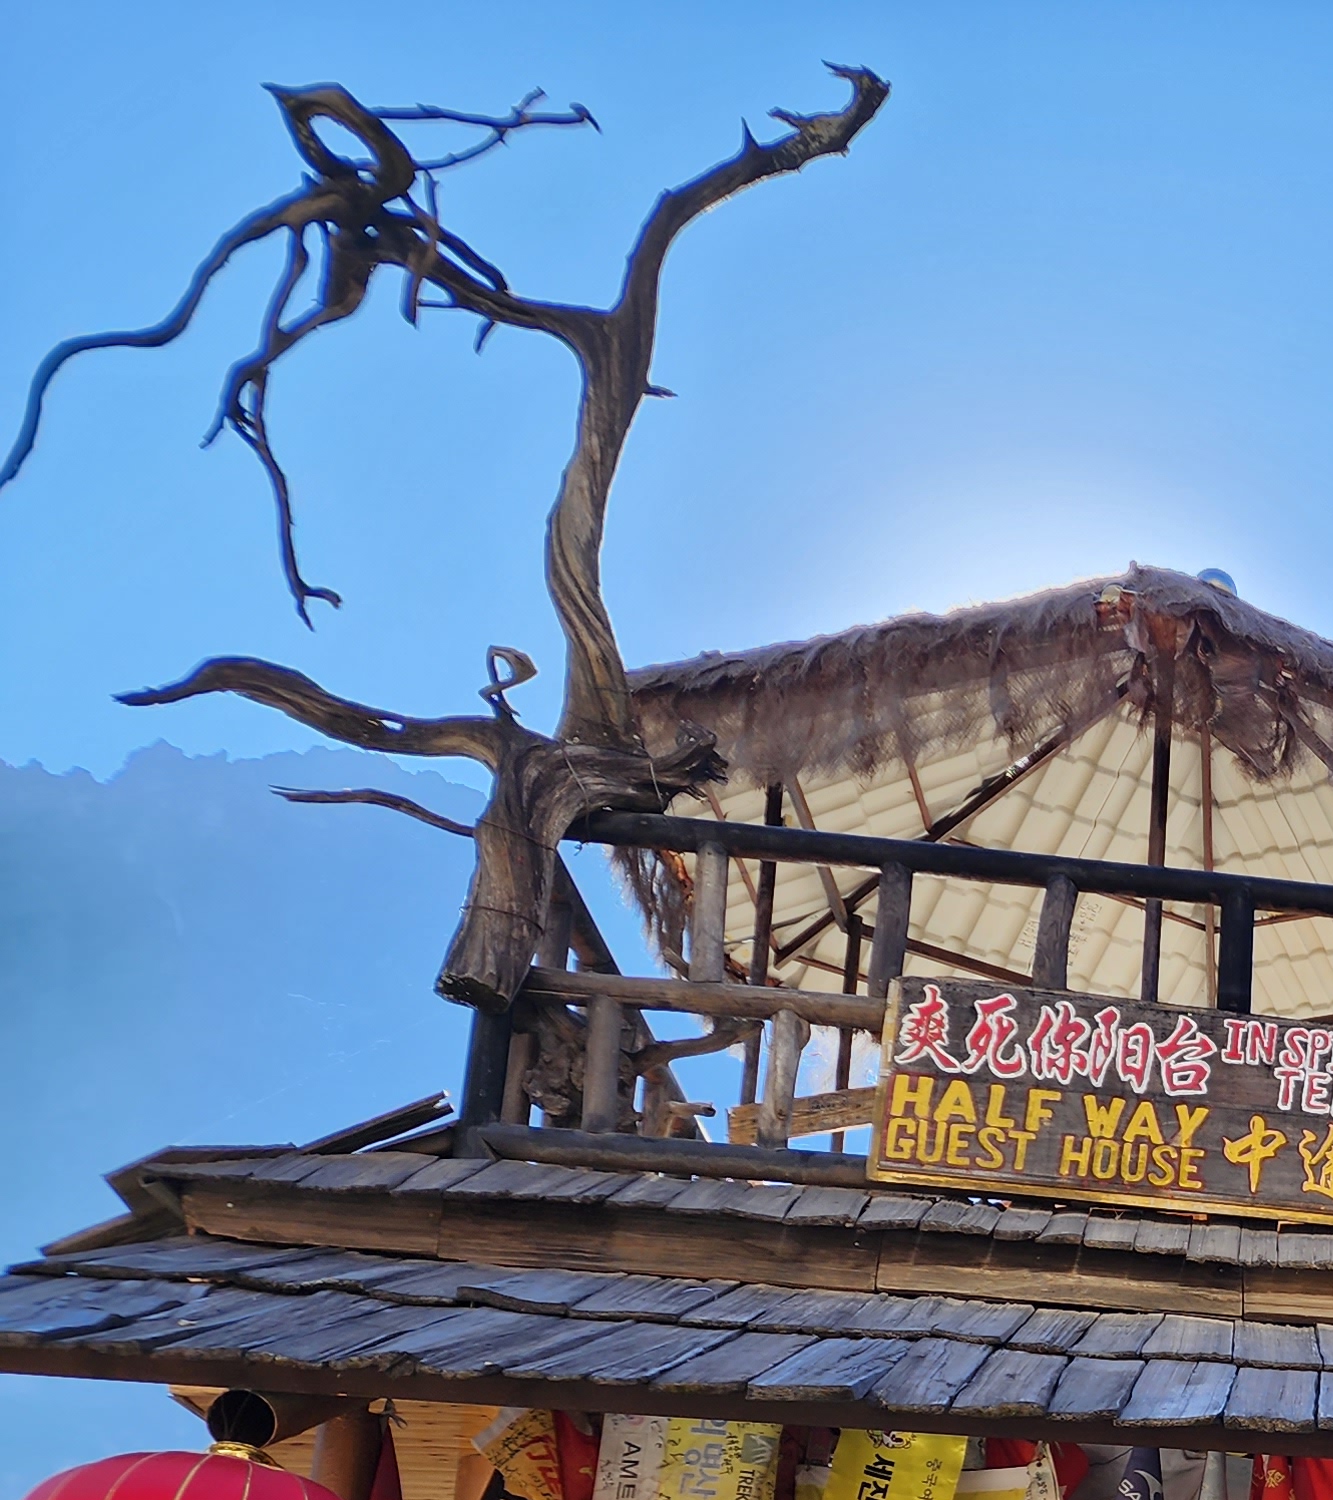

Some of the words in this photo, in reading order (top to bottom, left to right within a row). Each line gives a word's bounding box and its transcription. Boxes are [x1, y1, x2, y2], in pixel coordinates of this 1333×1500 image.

[895, 984, 1217, 1096] 爽死你阳台
[889, 1074, 1062, 1137] HALF
[1082, 1093, 1210, 1149] WAY
[885, 1117, 1036, 1171] GUEST
[1058, 1135, 1206, 1190] HOUSE
